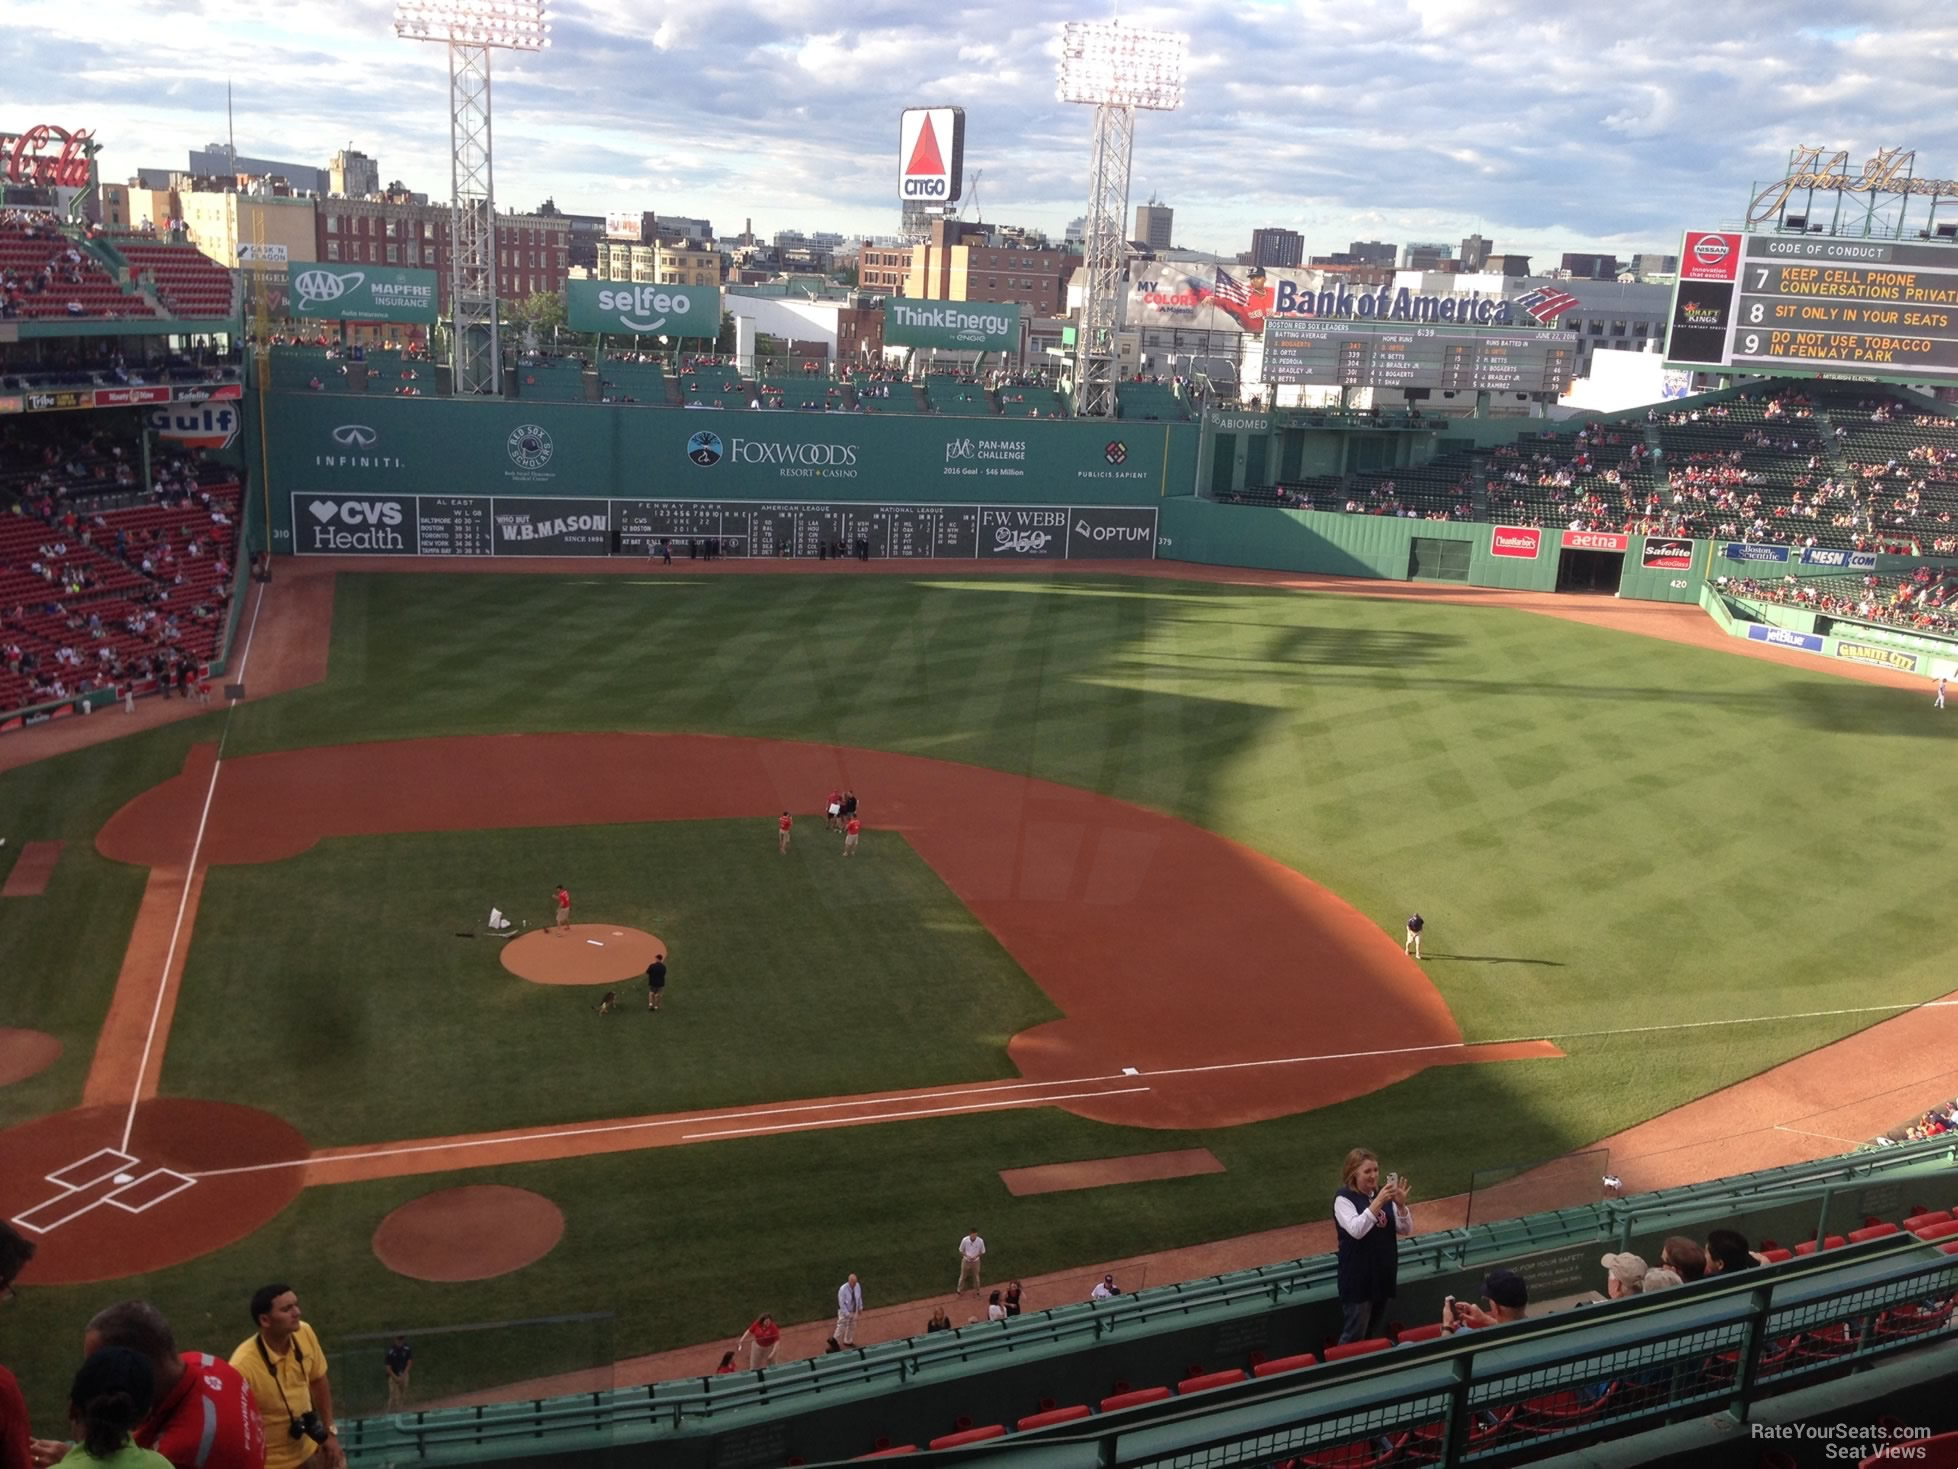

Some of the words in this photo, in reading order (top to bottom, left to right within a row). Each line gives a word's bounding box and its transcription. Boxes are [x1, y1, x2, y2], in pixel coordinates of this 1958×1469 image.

[904, 178, 946, 196] CITGO
[1746, 144, 1850, 224] John
[1769, 243, 1801, 254] CODE
[1806, 245, 1823, 255] OF
[1827, 246, 1885, 258] CONDUCT
[301, 270, 341, 301] AAA
[1755, 268, 1769, 289] 7
[1781, 268, 1819, 281] KEEP
[1824, 270, 1861, 284] CELL
[1867, 272, 1916, 287] PHONE
[371, 283, 431, 297] MAPFRE
[1137, 281, 1158, 292] MY
[1780, 281, 1900, 299] CONVERSATIONS
[375, 297, 428, 308] INSURANCE
[598, 286, 691, 316] selfeo
[1275, 281, 1351, 317] Bank
[1357, 284, 1391, 317] of
[1389, 287, 1512, 322] America
[358, 310, 389, 318] Insurance
[893, 306, 1009, 335] ThinkEnergy
[1750, 303, 1764, 324] 8
[1775, 305, 1797, 318] SIT
[1801, 306, 1839, 320] ONLY
[1843, 309, 1857, 321] IN
[1862, 310, 1899, 324] YOUR
[1903, 313, 1948, 327] SEATS
[1268, 321, 1293, 329] BOSTON
[1294, 322, 1306, 330] RED
[1417, 328, 1435, 337] 6:39
[1744, 334, 1759, 354] 9
[1771, 331, 1791, 344] DO
[1796, 333, 1825, 346] NOT
[1830, 335, 1858, 347] USE
[1864, 336, 1931, 352] TOBACCO
[1769, 344, 1784, 356] IN
[1789, 345, 1849, 360] FENWAY
[1854, 350, 1893, 362] PARK
[1823, 373, 1852, 382] MITSUBISHI
[1852, 375, 1878, 383] ELECTRIC
[29, 394, 54, 409] Tribe
[178, 391, 210, 400] Safelite
[145, 406, 232, 431] Gulf
[1220, 419, 1268, 429] ABIOMED
[510, 429, 525, 445] RED
[527, 426, 545, 438] SOX
[731, 438, 857, 466] FOXWOODS
[978, 440, 1026, 450] PAN-MASS
[316, 456, 399, 467] INFINITI
[511, 443, 551, 467] SCHOLARS
[977, 450, 1025, 460] CHALLENGE
[780, 468, 814, 477] RESORT
[822, 469, 858, 478] CASINO
[943, 467, 961, 475] 2016
[1000, 468, 1024, 476] Million
[340, 501, 402, 525] CVS
[515, 515, 531, 523] BUT
[983, 511, 1012, 526] F.W.
[1016, 511, 1065, 526] WEBB
[273, 529, 290, 538] 310
[313, 526, 404, 549] Health
[1093, 527, 1150, 541] OPTUM
[1158, 537, 1172, 546] 379
[1571, 534, 1617, 548] aetna
[1645, 546, 1691, 557] Safelite
[1739, 550, 1780, 561] Scientific
[1745, 545, 1771, 553] Boston
[1656, 560, 1689, 568] AutoGlass
[1670, 579, 1687, 588] 420
[1766, 628, 1806, 646] jetBlue
[1839, 644, 1888, 661] GRANITE
[1889, 652, 1915, 670] CITY
